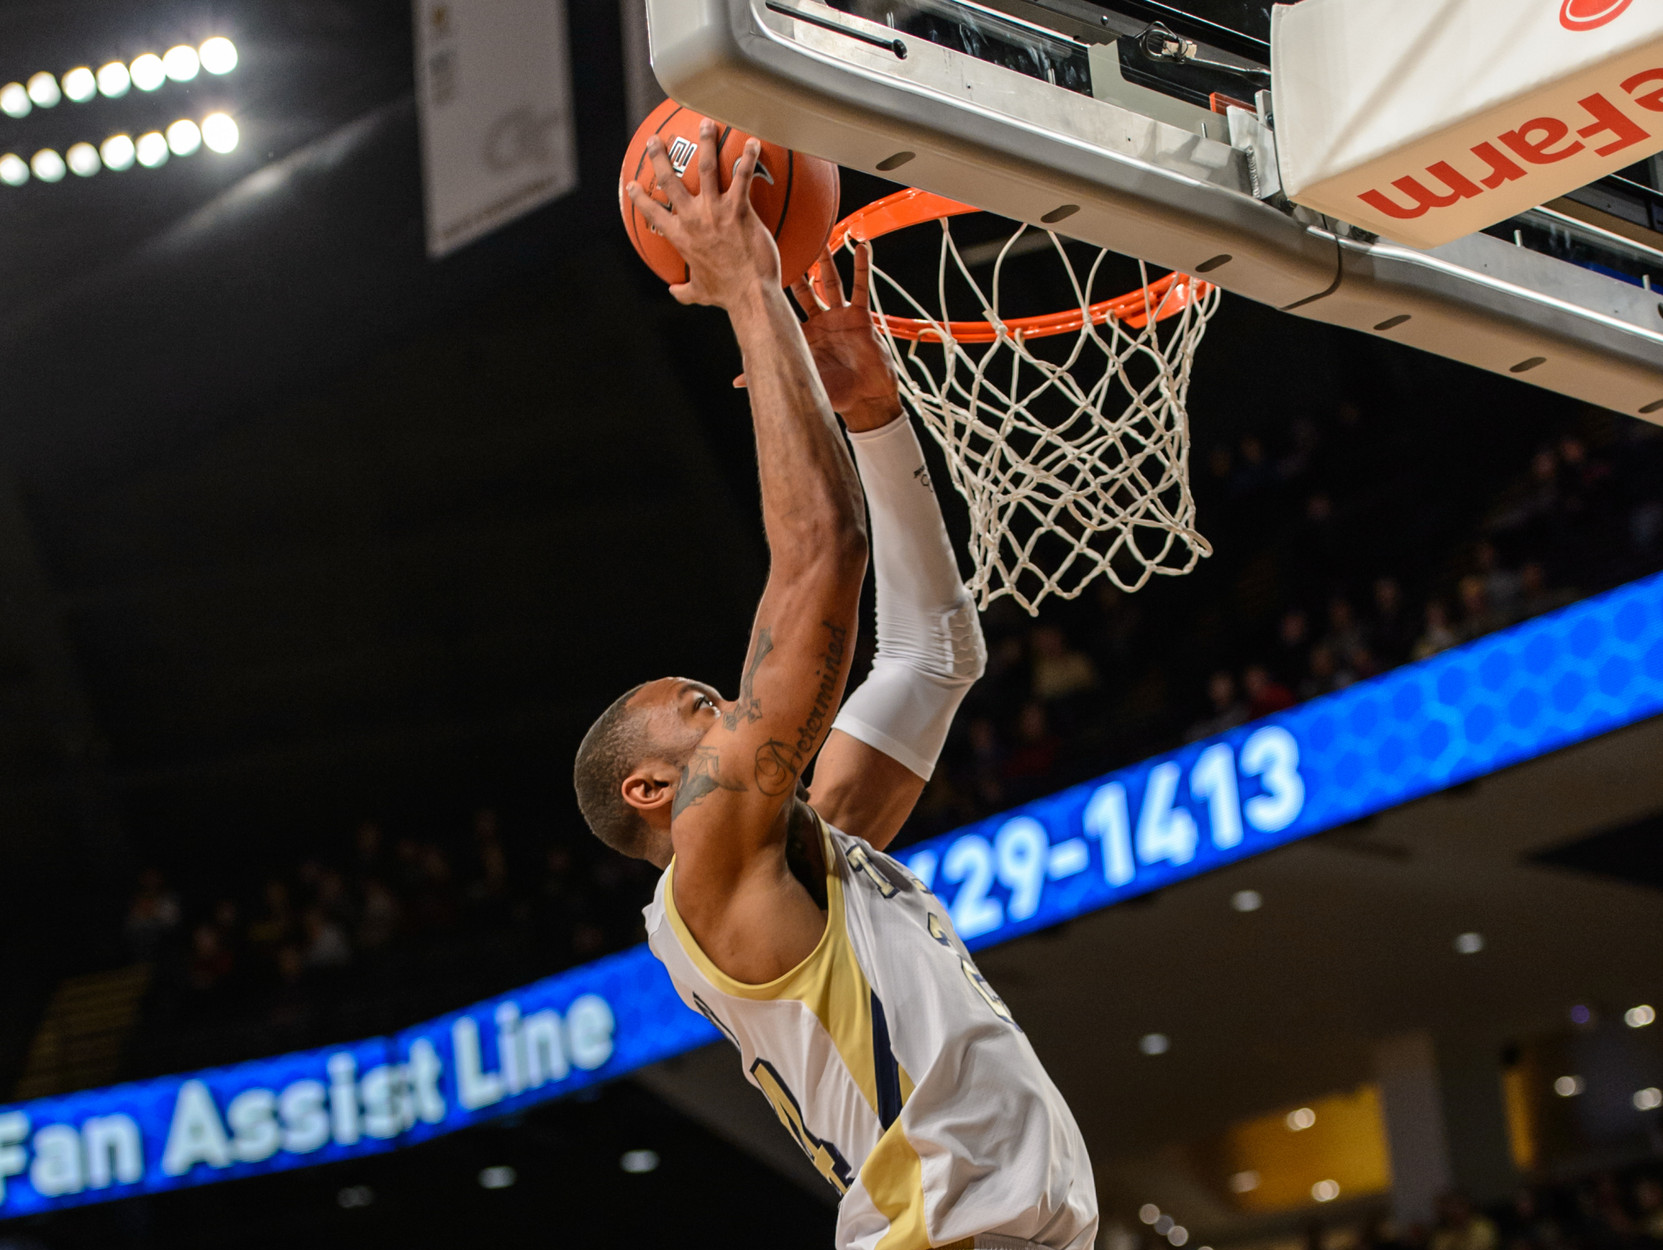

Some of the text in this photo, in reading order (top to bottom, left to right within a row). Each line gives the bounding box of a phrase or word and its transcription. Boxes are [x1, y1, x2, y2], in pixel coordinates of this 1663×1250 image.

[1357, 92, 1652, 220] Farm
[0, 1108, 143, 1198] Fan
[161, 1037, 447, 1177] Assist
[451, 994, 616, 1112] Line
